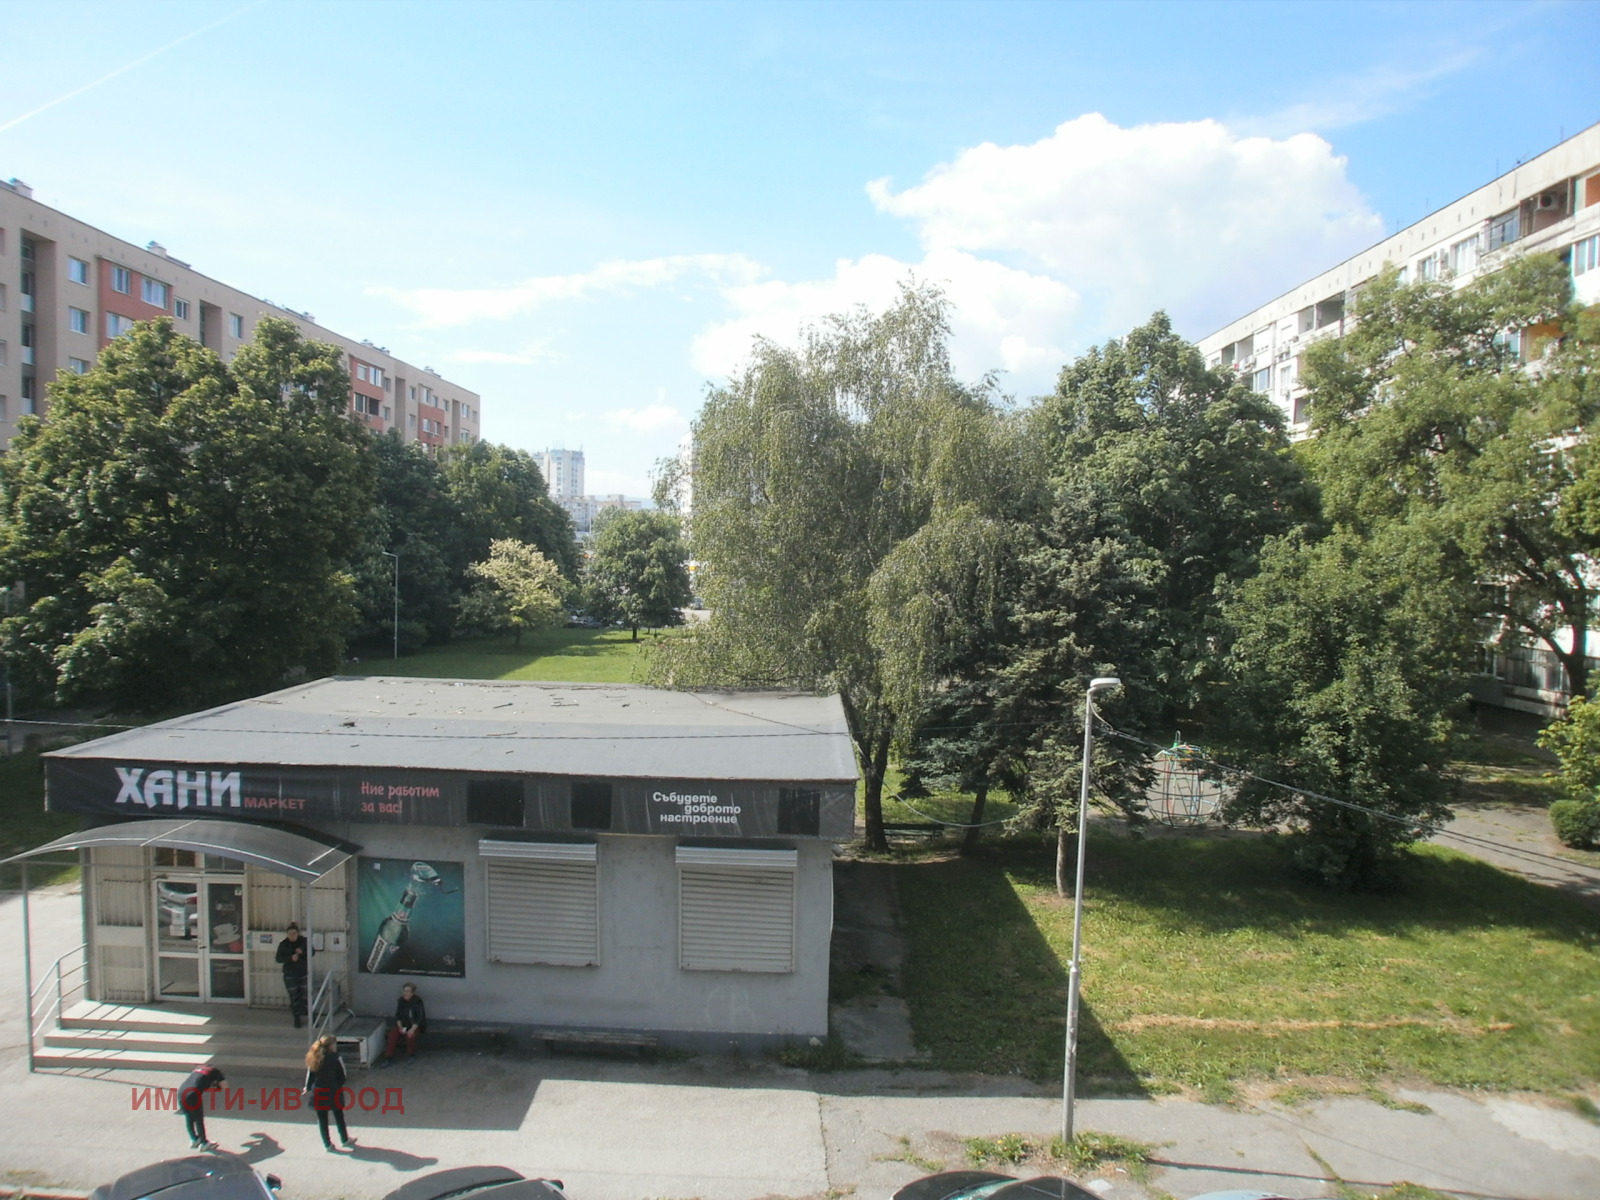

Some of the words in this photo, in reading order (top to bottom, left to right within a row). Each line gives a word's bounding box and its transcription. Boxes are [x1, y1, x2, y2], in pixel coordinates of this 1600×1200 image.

[114, 767, 241, 811] ХАНИ
[243, 797, 306, 811] МАРКЕТ
[361, 781, 386, 797] Ние
[387, 783, 440, 799] работим
[652, 792, 717, 804] Събудете
[361, 801, 377, 814] за
[378, 799, 403, 814] вас!
[684, 803, 741, 815] доброто
[660, 813, 738, 824] настроение
